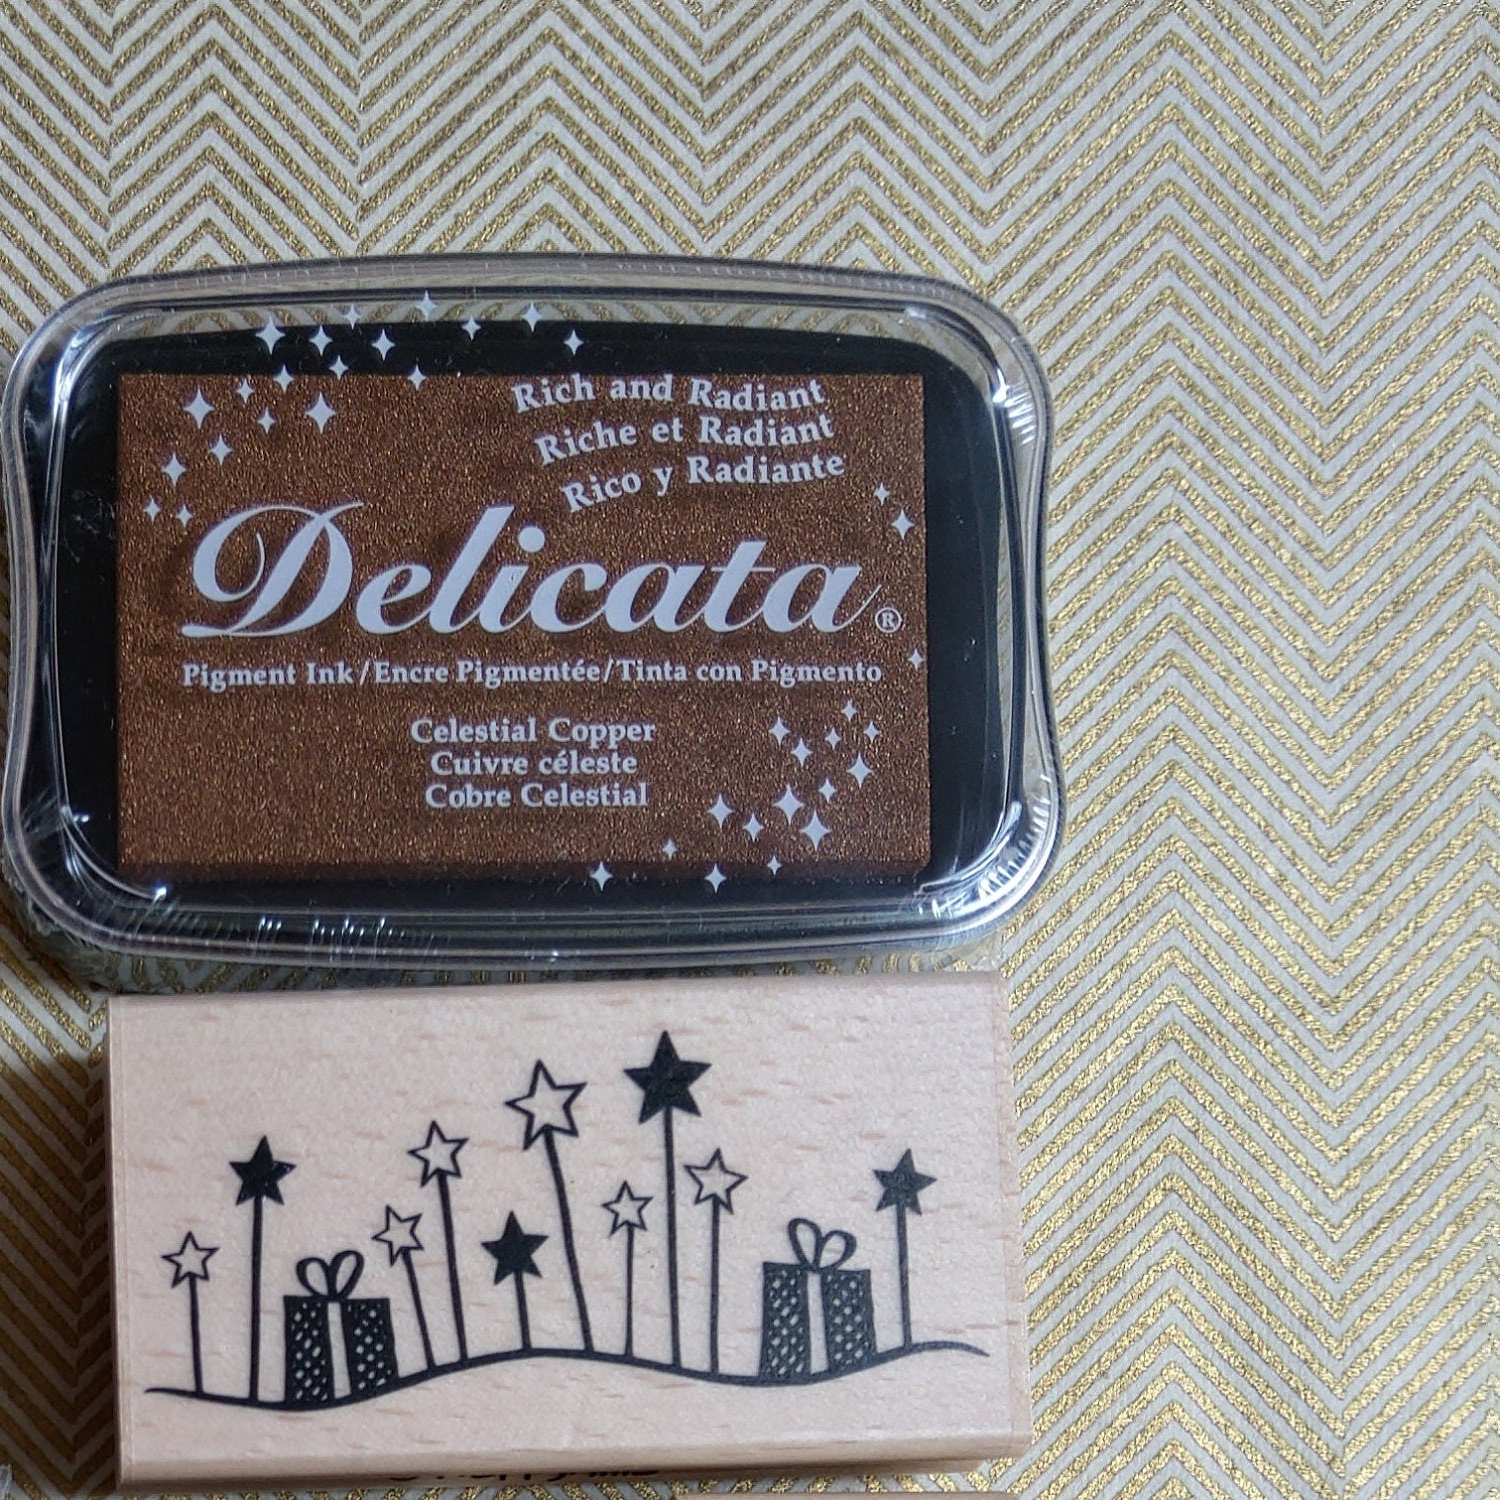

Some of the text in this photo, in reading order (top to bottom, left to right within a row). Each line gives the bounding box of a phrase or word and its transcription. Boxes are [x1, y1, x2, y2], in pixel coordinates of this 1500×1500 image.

[511, 373, 826, 413] Rich and Radiant
[534, 413, 835, 466] Riche et Radiant
[560, 453, 846, 513] Rico y Radiante
[182, 662, 297, 693] Pigment
[696, 663, 743, 682] con
[750, 659, 882, 688] Pigmento
[410, 716, 656, 751] Celestial Copper
[430, 750, 638, 776] Cuivre céleste
[425, 782, 649, 808] Cobre Celestial
